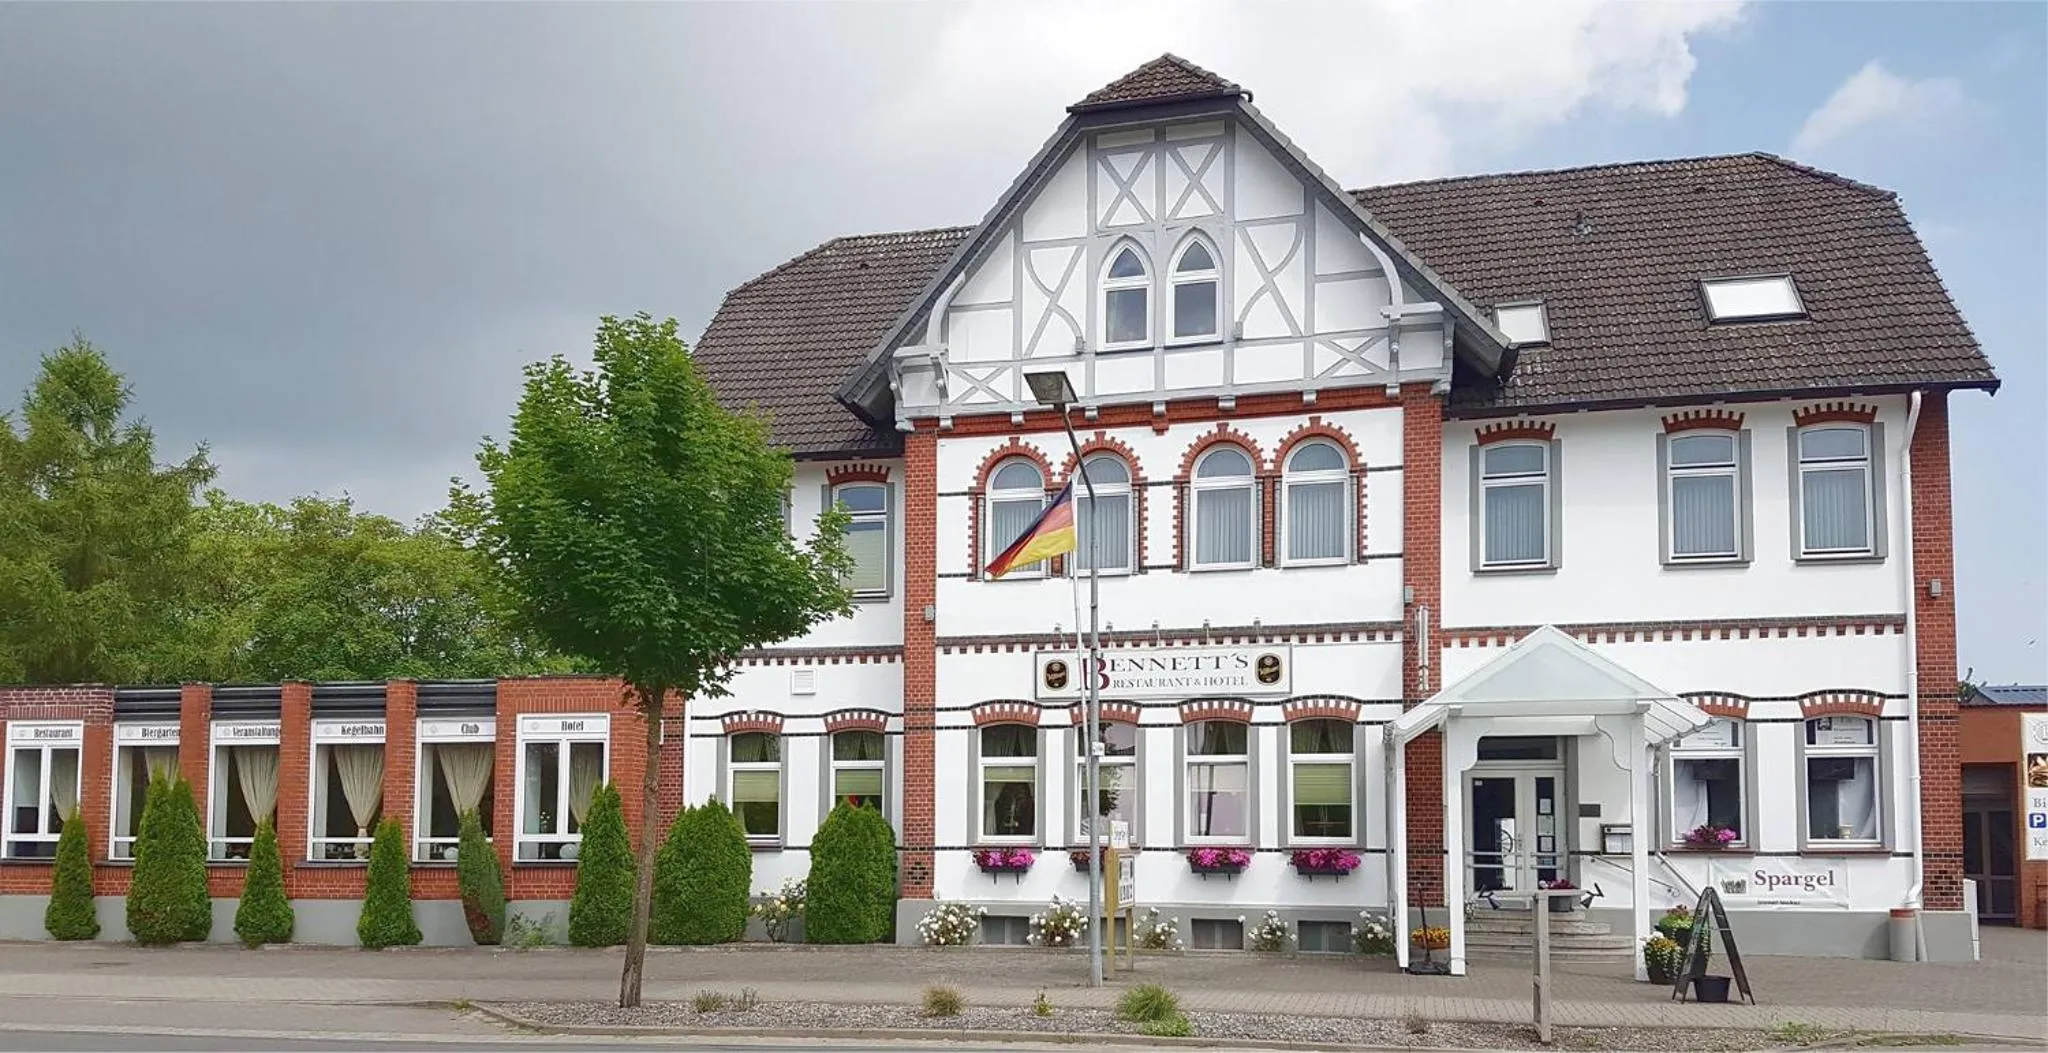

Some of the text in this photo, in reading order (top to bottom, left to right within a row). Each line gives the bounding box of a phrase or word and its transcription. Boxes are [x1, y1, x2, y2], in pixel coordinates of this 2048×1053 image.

[1113, 677, 1194, 688] RESTAURANT
[1203, 676, 1248, 686] HOTEL
[341, 725, 384, 736] Kegelbahn
[461, 723, 479, 734] Club
[561, 721, 584, 731] Hotel
[34, 728, 73, 738] Restaurant
[1754, 870, 1835, 892] Spargel
